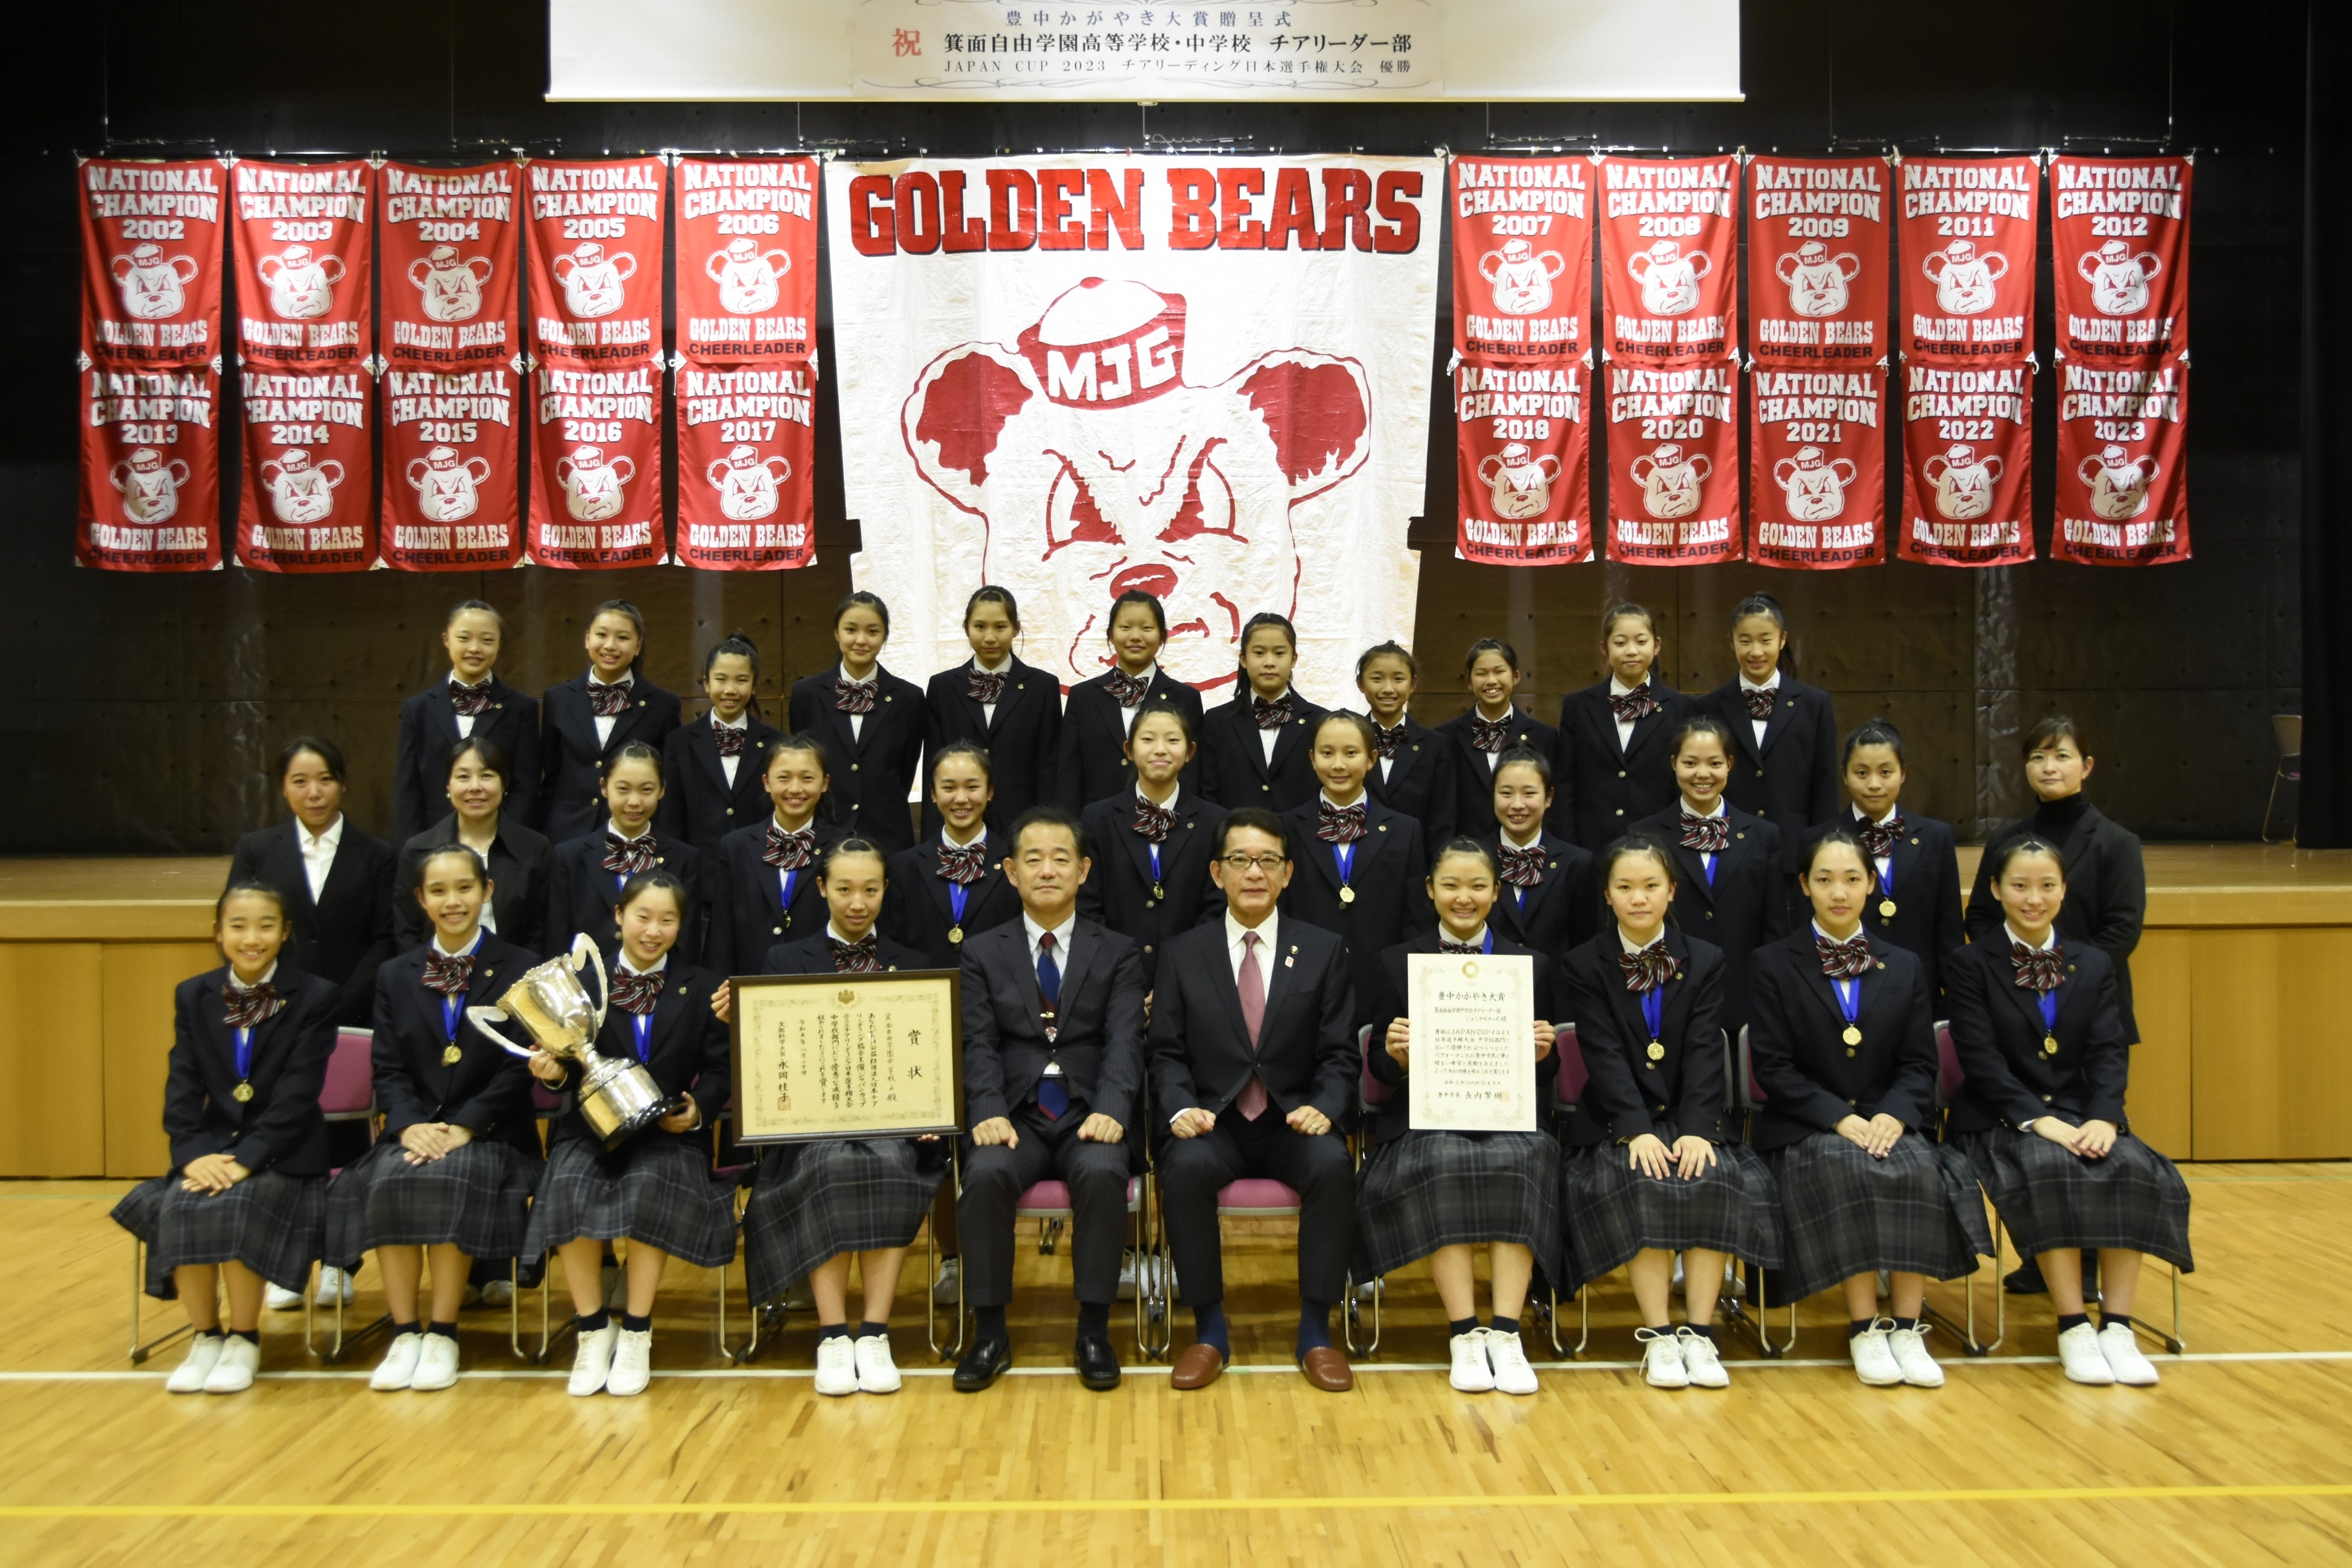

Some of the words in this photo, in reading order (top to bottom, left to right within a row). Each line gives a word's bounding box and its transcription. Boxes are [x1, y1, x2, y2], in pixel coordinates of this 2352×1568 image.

[1007, 10, 1292, 27] 豊中かがやき大賞贈呈式
[892, 28, 922, 57] 祝
[944, 33, 1251, 52] 箕面自由学園高等学校・中学校
[1269, 34, 1412, 52] チアリーダー部
[944, 60, 1002, 72] JAPAN
[1015, 61, 1049, 72] CUP
[1063, 61, 1105, 72] 2023
[1122, 60, 1363, 73] チアリーディング日本選手権大会
[1380, 60, 1411, 73] 優勝
[88, 166, 218, 194] NATIONAL
[238, 167, 365, 194] NATIONAL
[388, 168, 512, 195] NATIONAL
[532, 165, 658, 191] NATIONAL
[684, 164, 812, 191] NATIONAL
[1458, 163, 1585, 190] NATIONAL
[1606, 164, 1730, 190] NATIONAL
[1756, 164, 1880, 192] NATIONAL
[1904, 164, 2029, 192] NATIONAL
[2058, 165, 2181, 191] NATIONAL
[92, 194, 218, 223] CHAMPION
[240, 195, 365, 223] CHAMPION
[388, 197, 511, 223] CHAMPION
[533, 192, 657, 221] CHAMPION
[685, 189, 811, 221] CHAMPION
[849, 169, 1144, 256] GOLDEN
[1166, 167, 1423, 256] BEARS
[1459, 190, 1584, 219] CHAMPION
[1608, 191, 1730, 219] CHAMPION
[1756, 192, 1880, 223] CHAMPION
[1905, 191, 2029, 220] CHAMPION
[2058, 192, 2180, 220] CHAMPION
[122, 220, 184, 241] 2002
[273, 221, 332, 241] 2003
[419, 221, 479, 241] 2004
[564, 218, 625, 239] 2005
[718, 215, 779, 235] 2006
[1492, 215, 1552, 235] 2007
[1639, 217, 1701, 237] 2008
[1789, 217, 1848, 237] 2009
[1938, 216, 1994, 236] 2011
[2092, 216, 2148, 236] 2012
[243, 321, 303, 347] GOLDEN
[309, 321, 359, 347] BEARS
[394, 321, 453, 349] GOLDEN
[458, 320, 505, 349] BEARS
[539, 317, 596, 345] GOLDEN
[601, 318, 651, 344] BEARS
[689, 317, 750, 342] GOLDEN
[755, 317, 806, 341] BEARS
[1467, 315, 1525, 342] GOLDEN
[1529, 317, 1578, 342] BEARS
[1615, 315, 1673, 343] GOLDEN
[1677, 315, 1724, 343] BEARS
[1760, 319, 1819, 344] GOLDEN
[1825, 321, 1873, 344] BEARS
[1913, 314, 1967, 341] GOLDEN
[1973, 315, 2024, 341] BEARS
[393, 345, 506, 362] CHEERLEADER
[540, 343, 648, 359] CHEERLEADER
[689, 342, 806, 355] CHEERLEADER
[1466, 341, 1578, 355] CHEERLEADER
[1615, 341, 1724, 356] CHEERLEADER
[1759, 344, 1873, 358] CHEERLEADER
[1914, 341, 2023, 355] CHEERLEADER
[1047, 325, 1177, 402] MJG
[92, 372, 211, 399] NATIONAL
[244, 373, 363, 399] NATIONAL
[390, 371, 510, 397] NATIONAL
[539, 368, 653, 395] NATIONAL
[688, 371, 811, 397] NATIONAL
[1461, 367, 1580, 394] NATIONAL
[1613, 369, 1731, 395] NATIONAL
[1756, 371, 1877, 399] NATIONAL
[1909, 367, 2023, 394] NATIONAL
[2065, 365, 2178, 394] NATIONAL
[92, 399, 210, 429] CHAMPION
[393, 397, 509, 426] CHAMPION
[541, 396, 653, 425] CHAMPION
[688, 396, 810, 426] CHAMPION
[1461, 394, 1579, 424] CHAMPION
[1613, 395, 1730, 423] CHAMPION
[1759, 399, 1876, 428] CHAMPION
[1908, 395, 2022, 425] CHAMPION
[2063, 395, 2178, 423] CHAMPION
[122, 424, 177, 444] 2013
[272, 425, 329, 444] 2014
[420, 422, 476, 442] 2015
[565, 421, 622, 442] 2016
[721, 422, 776, 442] 2017
[1493, 419, 1549, 440] 2018
[1642, 419, 1703, 439] 2020
[1786, 422, 1841, 442] 2021
[1939, 420, 1993, 440] 2022
[2094, 420, 2146, 441] 2023
[434, 460, 455, 469] MJG
[734, 458, 755, 468] MJG
[1658, 455, 1680, 466] MJG
[252, 525, 305, 551] GOLDEN
[310, 525, 364, 551] BEARS
[394, 525, 450, 549] GOLDEN
[456, 524, 509, 549] BEARS
[541, 524, 596, 548] GOLDEN
[602, 522, 652, 548] BEARS
[690, 524, 751, 547] GOLDEN
[756, 523, 805, 547] BEARS
[1465, 519, 1522, 546] GOLDEN
[1526, 520, 1578, 546] BEARS
[1617, 519, 1674, 545] GOLDEN
[1679, 517, 1729, 545] BEARS
[1759, 522, 1818, 548] GOLDEN
[1822, 522, 1874, 548] BEARS
[1912, 517, 1966, 546] GOLDEN
[1971, 520, 2019, 546] BEARS
[2064, 519, 2121, 546] GOLDEN
[249, 549, 364, 564] CHEERLEADER
[393, 549, 510, 564] CHEERLEADER
[539, 548, 653, 563] CHEERLEADER
[689, 548, 803, 561] CHEERLEADER
[1467, 543, 1578, 559] CHEERLEADER
[1619, 542, 1730, 558] CHEERLEADER
[1759, 547, 1874, 562] CHEERLEADER
[1911, 542, 2021, 560] CHEERLEADER
[2064, 543, 2177, 560] CHEERLEADER
[1438, 991, 1505, 1002] 豊中かがやき大賞
